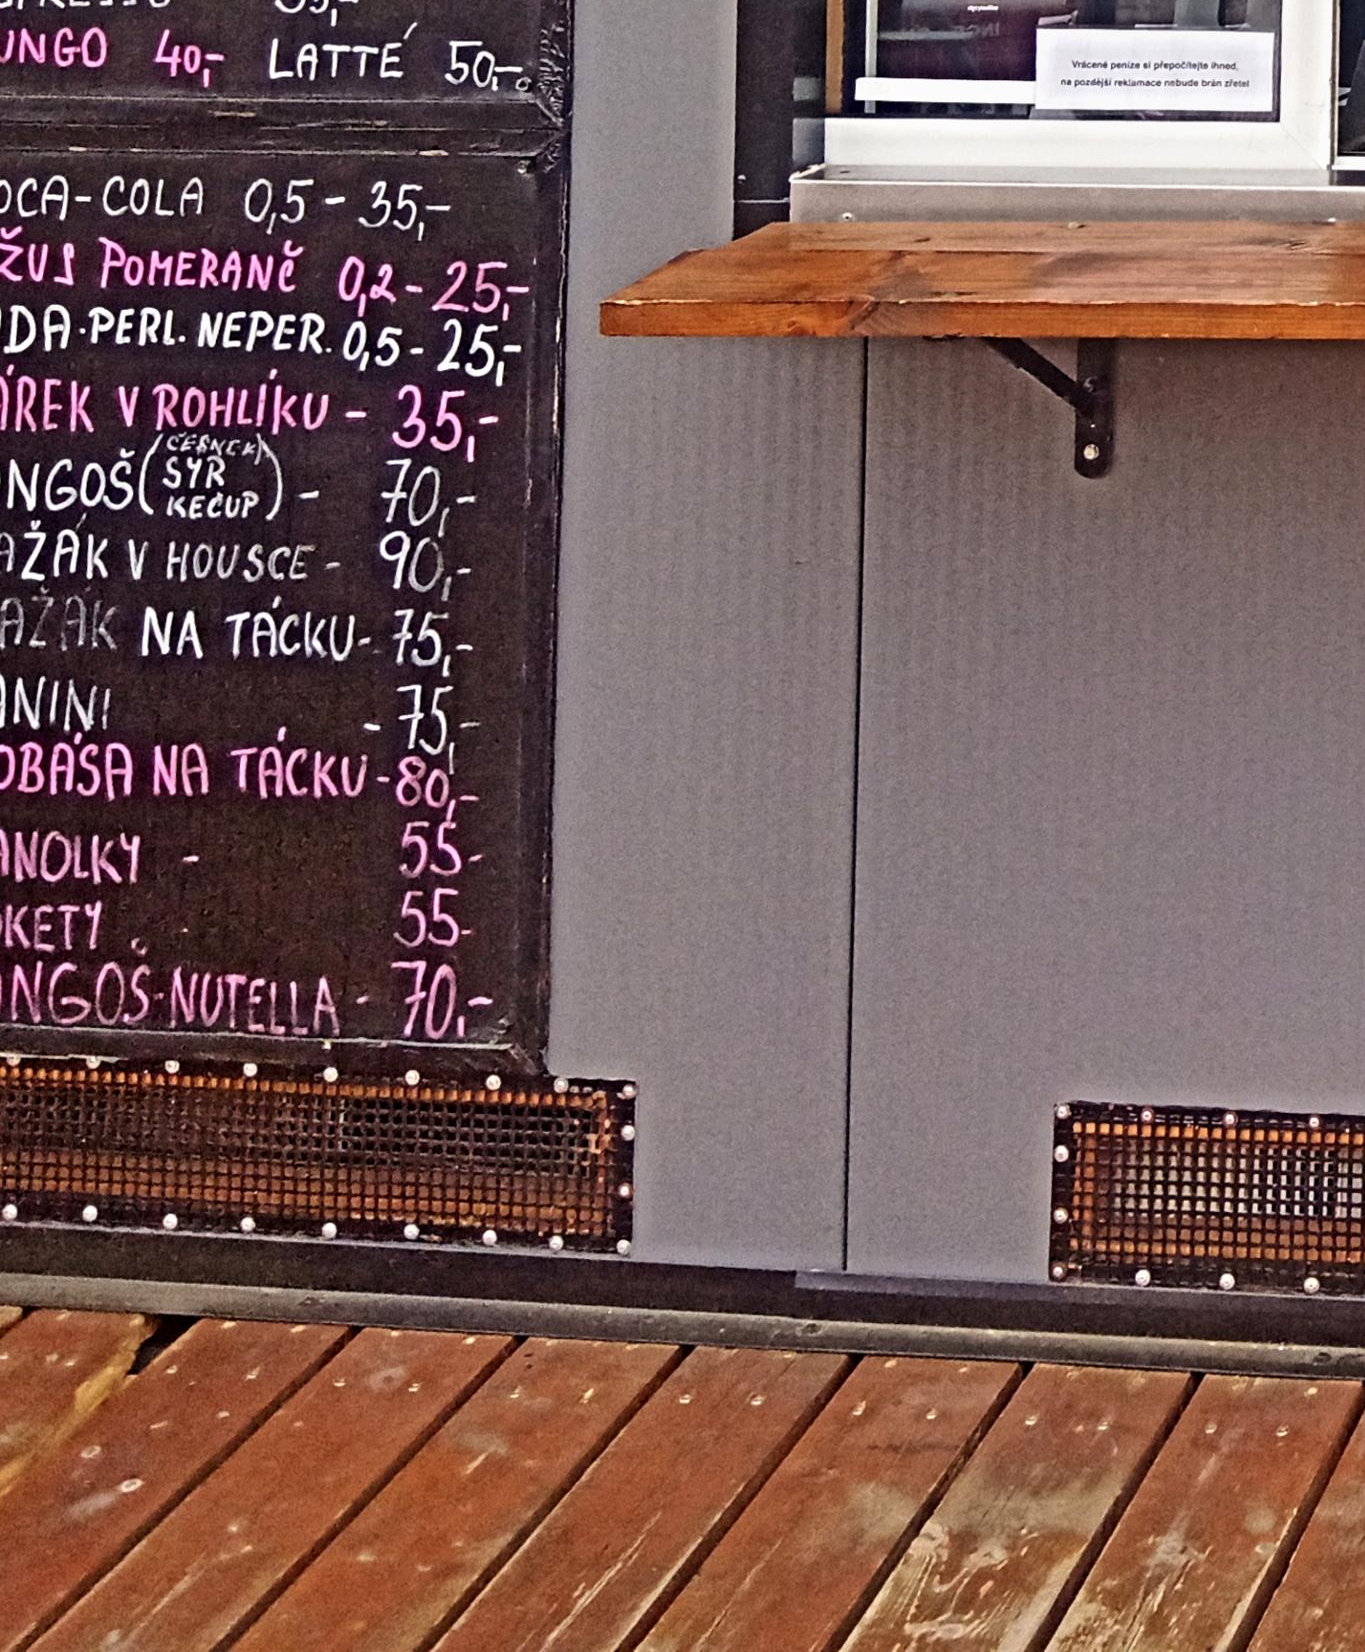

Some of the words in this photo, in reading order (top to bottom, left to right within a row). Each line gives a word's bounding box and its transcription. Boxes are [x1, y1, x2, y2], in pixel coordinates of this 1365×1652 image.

[1072, 60, 1107, 69] Vrácené
[1111, 61, 1140, 72] peníze
[1154, 61, 1208, 72] přepočítejte
[1074, 78, 1111, 88] pozdější
[1114, 79, 1161, 87] reklamace
[1164, 79, 1198, 87] nebude
[99, 237, 304, 293] POMERANČ
[153, 368, 330, 436] ROHLÍKU
[167, 541, 315, 582] HOUSCE
[141, 606, 203, 660] NA
[153, 743, 209, 797] NA
